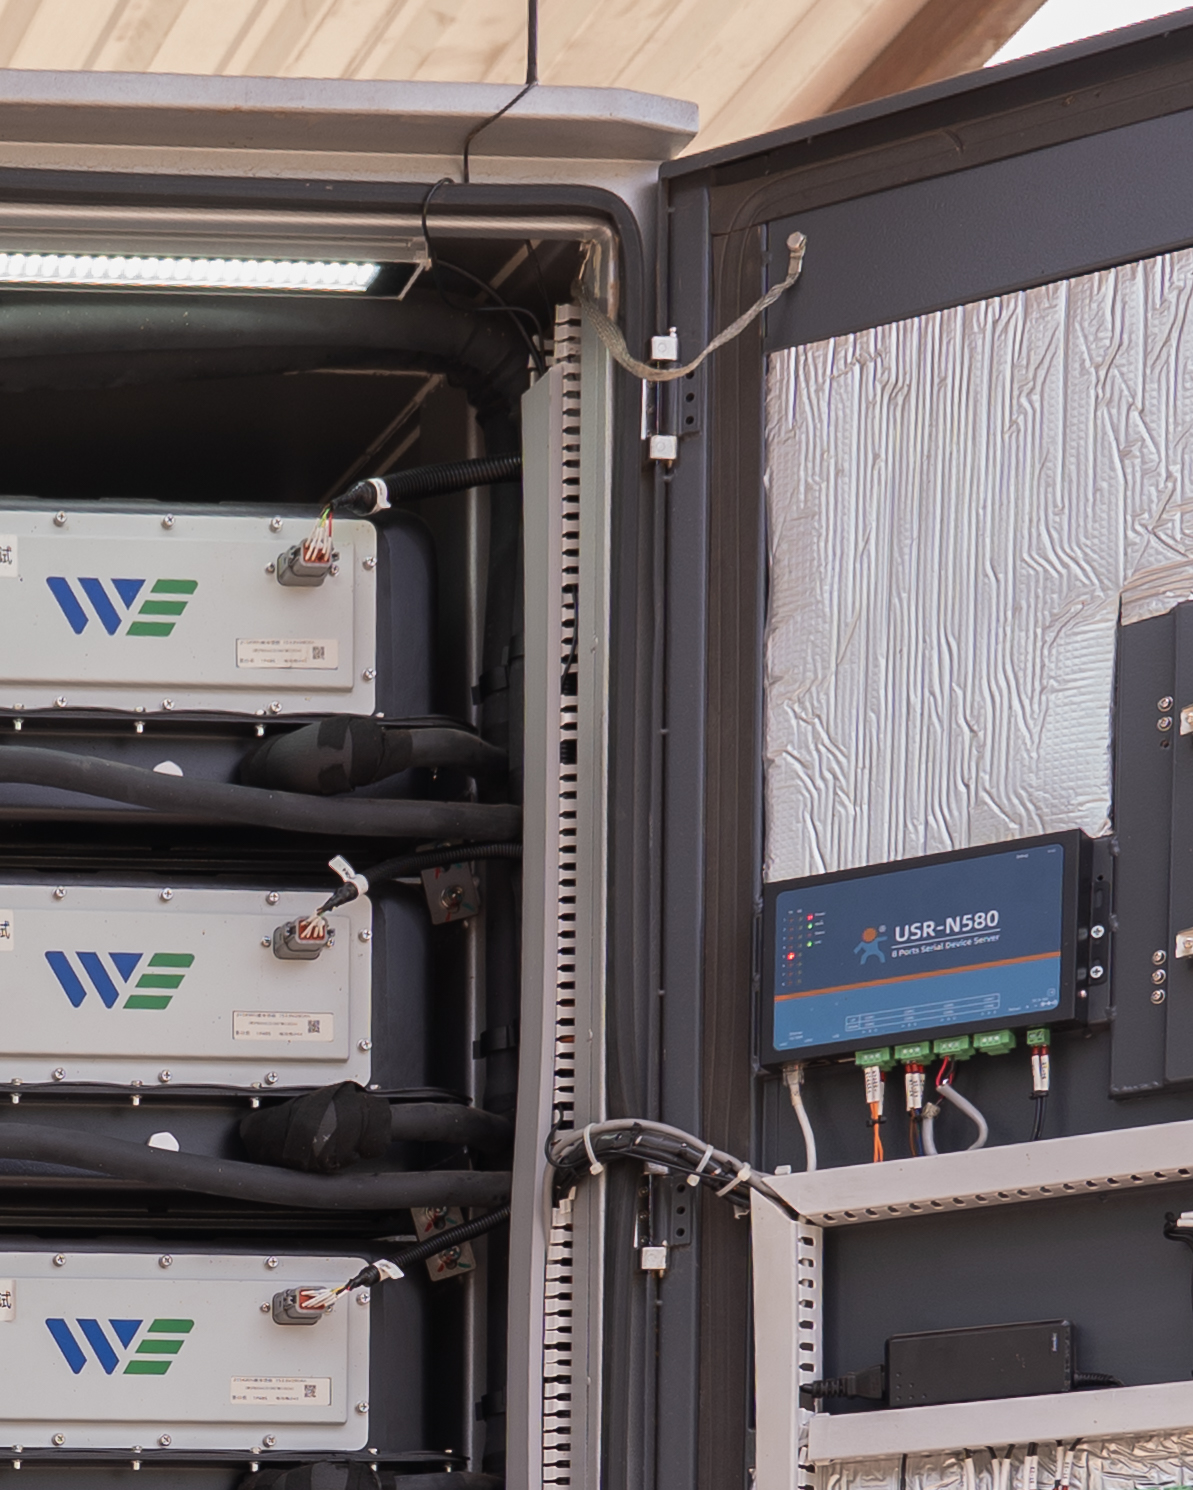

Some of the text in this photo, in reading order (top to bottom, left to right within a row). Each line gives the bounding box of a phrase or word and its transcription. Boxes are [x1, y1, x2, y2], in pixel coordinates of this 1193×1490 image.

[894, 910, 999, 942] USR-N580
[891, 934, 1000, 958] 8 Ports Serial Device Server
